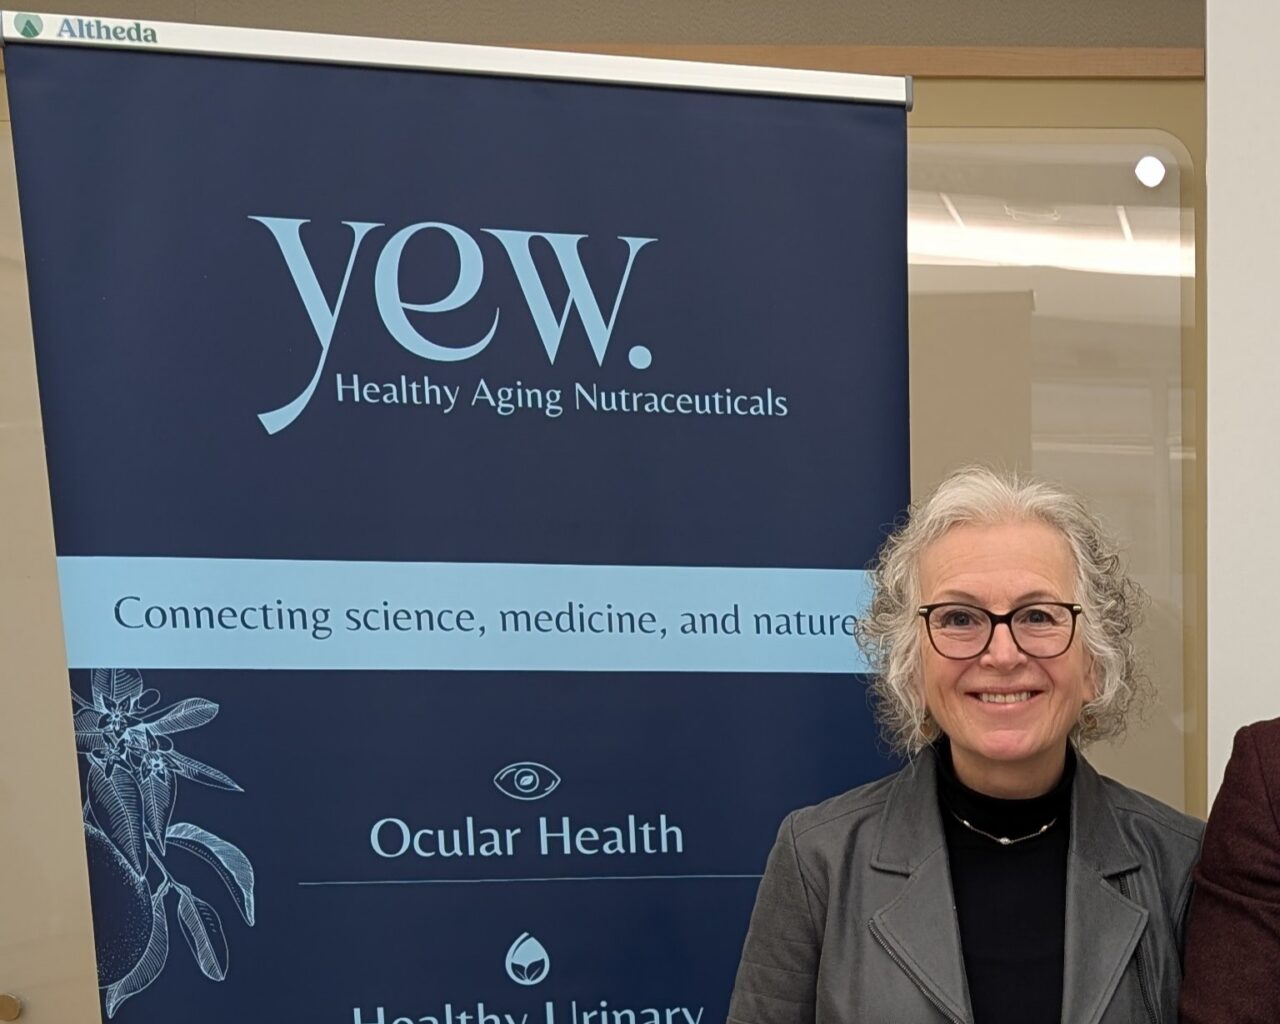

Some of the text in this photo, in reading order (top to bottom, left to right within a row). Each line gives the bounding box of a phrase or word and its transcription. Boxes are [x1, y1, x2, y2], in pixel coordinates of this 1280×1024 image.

[57, 18, 157, 43] Altheda
[248, 216, 658, 435] yew.
[336, 373, 788, 417] Healthy Aging Nutraceuticals
[113, 596, 857, 640] Connecting science, medicine, and nature
[371, 814, 684, 858] Ocular Health
